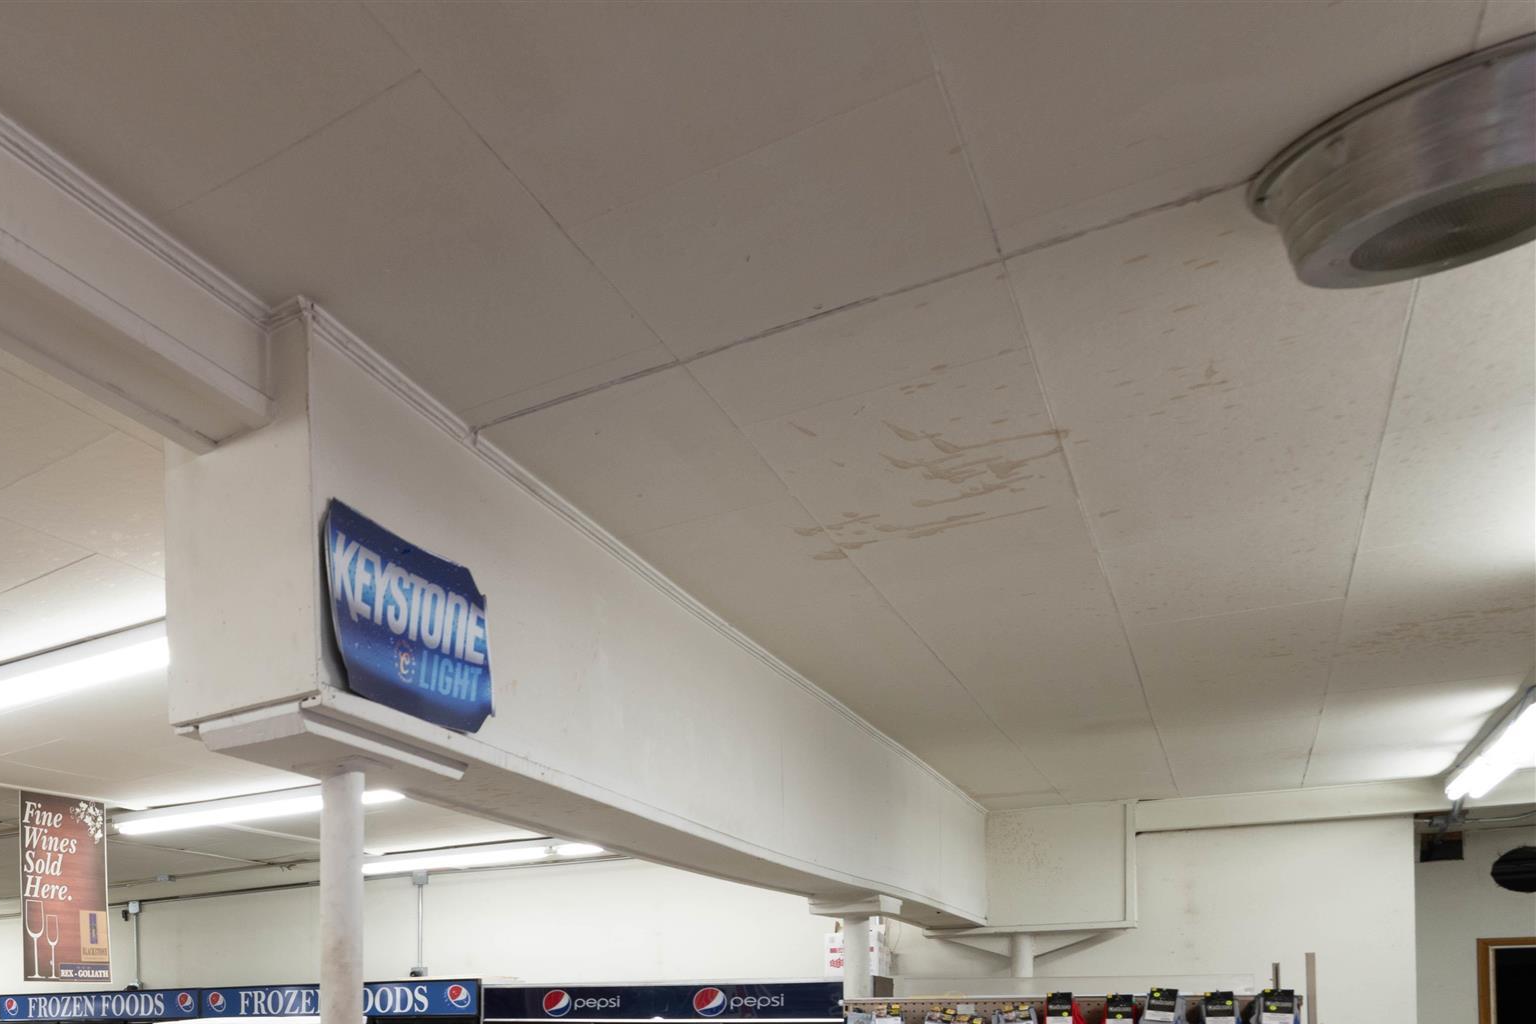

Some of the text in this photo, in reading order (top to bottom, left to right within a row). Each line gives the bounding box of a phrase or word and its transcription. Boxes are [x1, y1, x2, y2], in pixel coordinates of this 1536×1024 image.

[330, 530, 487, 665] KEYSTONE
[418, 649, 482, 702] LIGHT
[23, 800, 63, 828] Fine
[23, 826, 77, 854] Wines
[24, 851, 62, 876] Sold
[24, 875, 72, 901] Here.
[27, 993, 165, 1019] FROZEN FOODS
[574, 994, 621, 1012] pepsi
[730, 992, 785, 1011] pepsi
